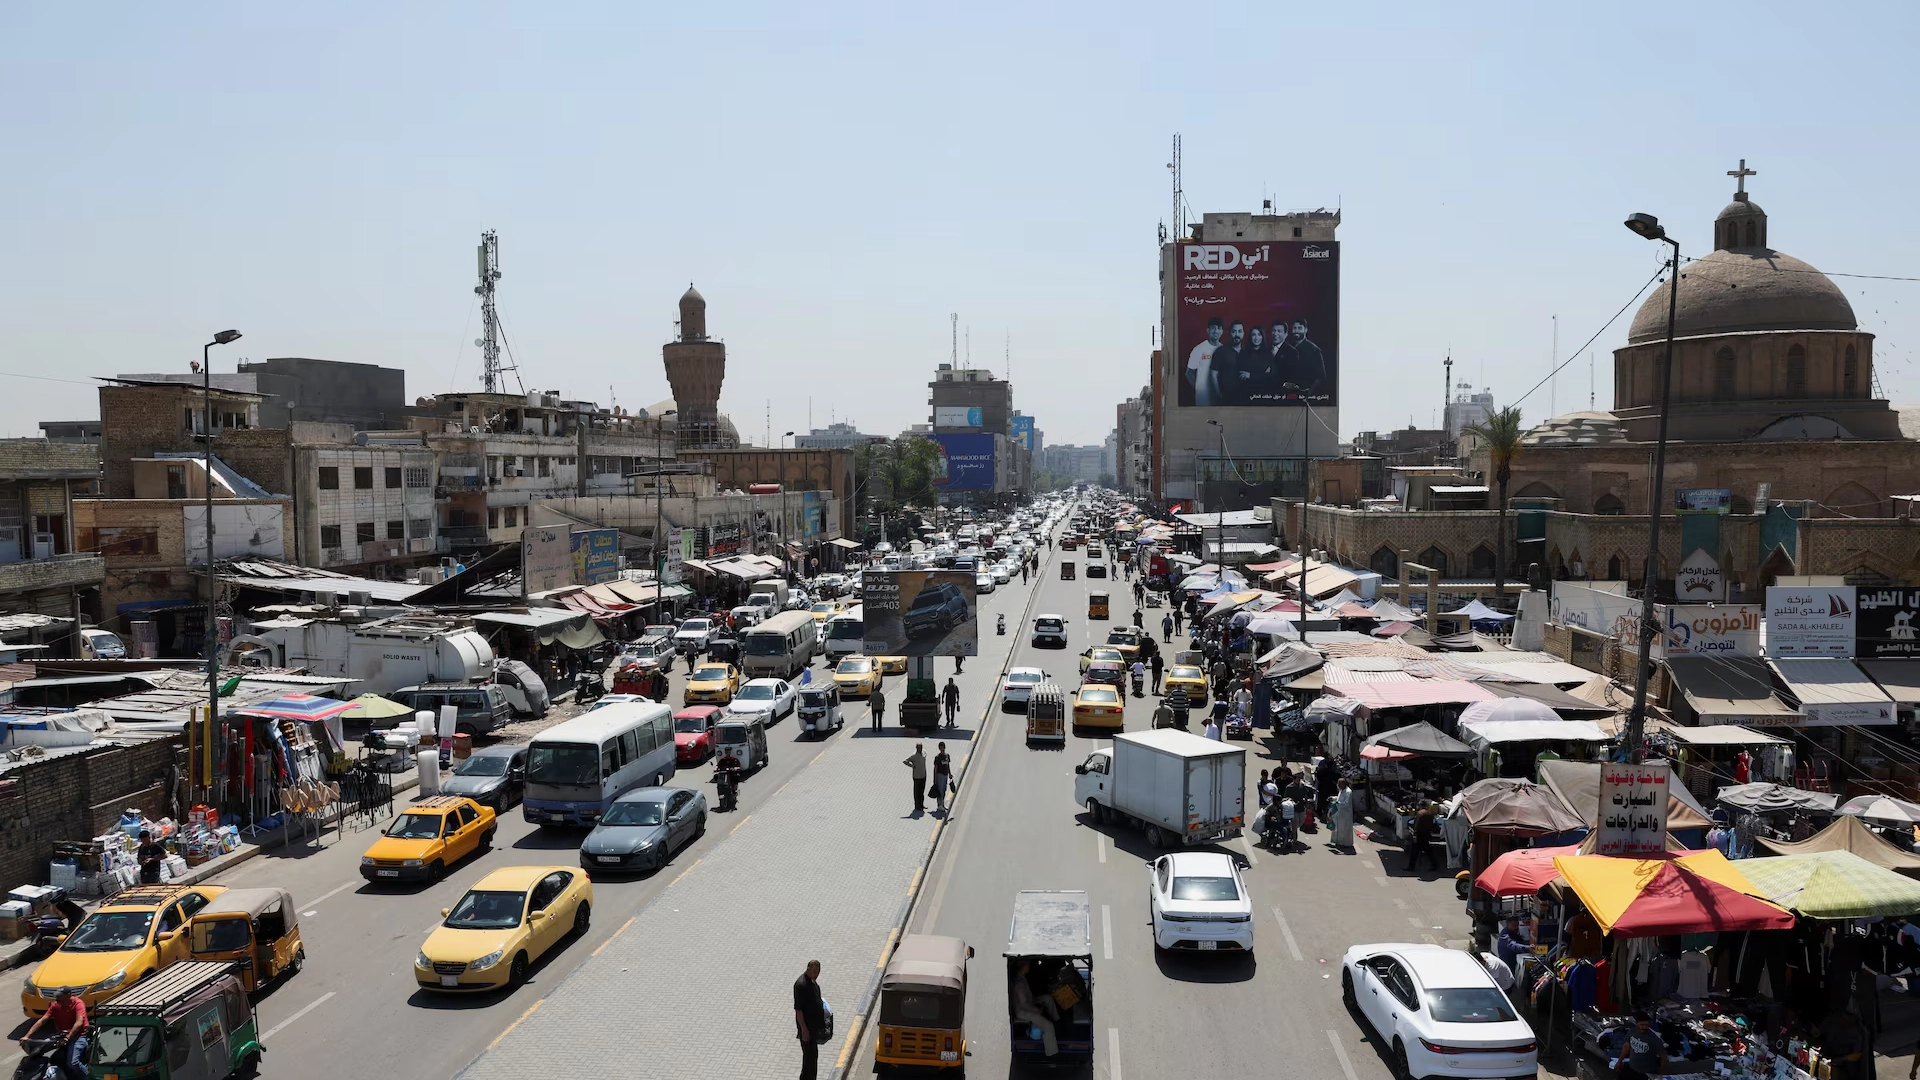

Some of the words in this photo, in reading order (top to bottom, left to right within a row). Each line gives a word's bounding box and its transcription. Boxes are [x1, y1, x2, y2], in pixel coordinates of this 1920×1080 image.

[1184, 245, 1240, 270] RED
[1242, 245, 1270, 269] آني
[1302, 248, 1330, 258] Asiacell
[527, 544, 532, 555] 2
[1678, 568, 1701, 576] الركابي
[1684, 577, 1715, 587] PRIME
[884, 601, 900, 610] 403
[1787, 595, 1812, 605] شركة
[1860, 591, 1903, 609] الخليج
[1562, 607, 1588, 627] للتوصيل
[1774, 606, 1798, 616] الخليج
[1800, 608, 1825, 616] صدى
[1692, 606, 1758, 636] الأمزون
[1694, 640, 1735, 653] للتوصيل
[1757, 716, 1800, 725] الأمزون
[1605, 770, 1634, 786] وقوف
[1637, 770, 1665, 784] ساحة
[1613, 791, 1656, 809] السيارت
[1606, 814, 1658, 832] والدراجات
[1601, 839, 1622, 852] العربي
